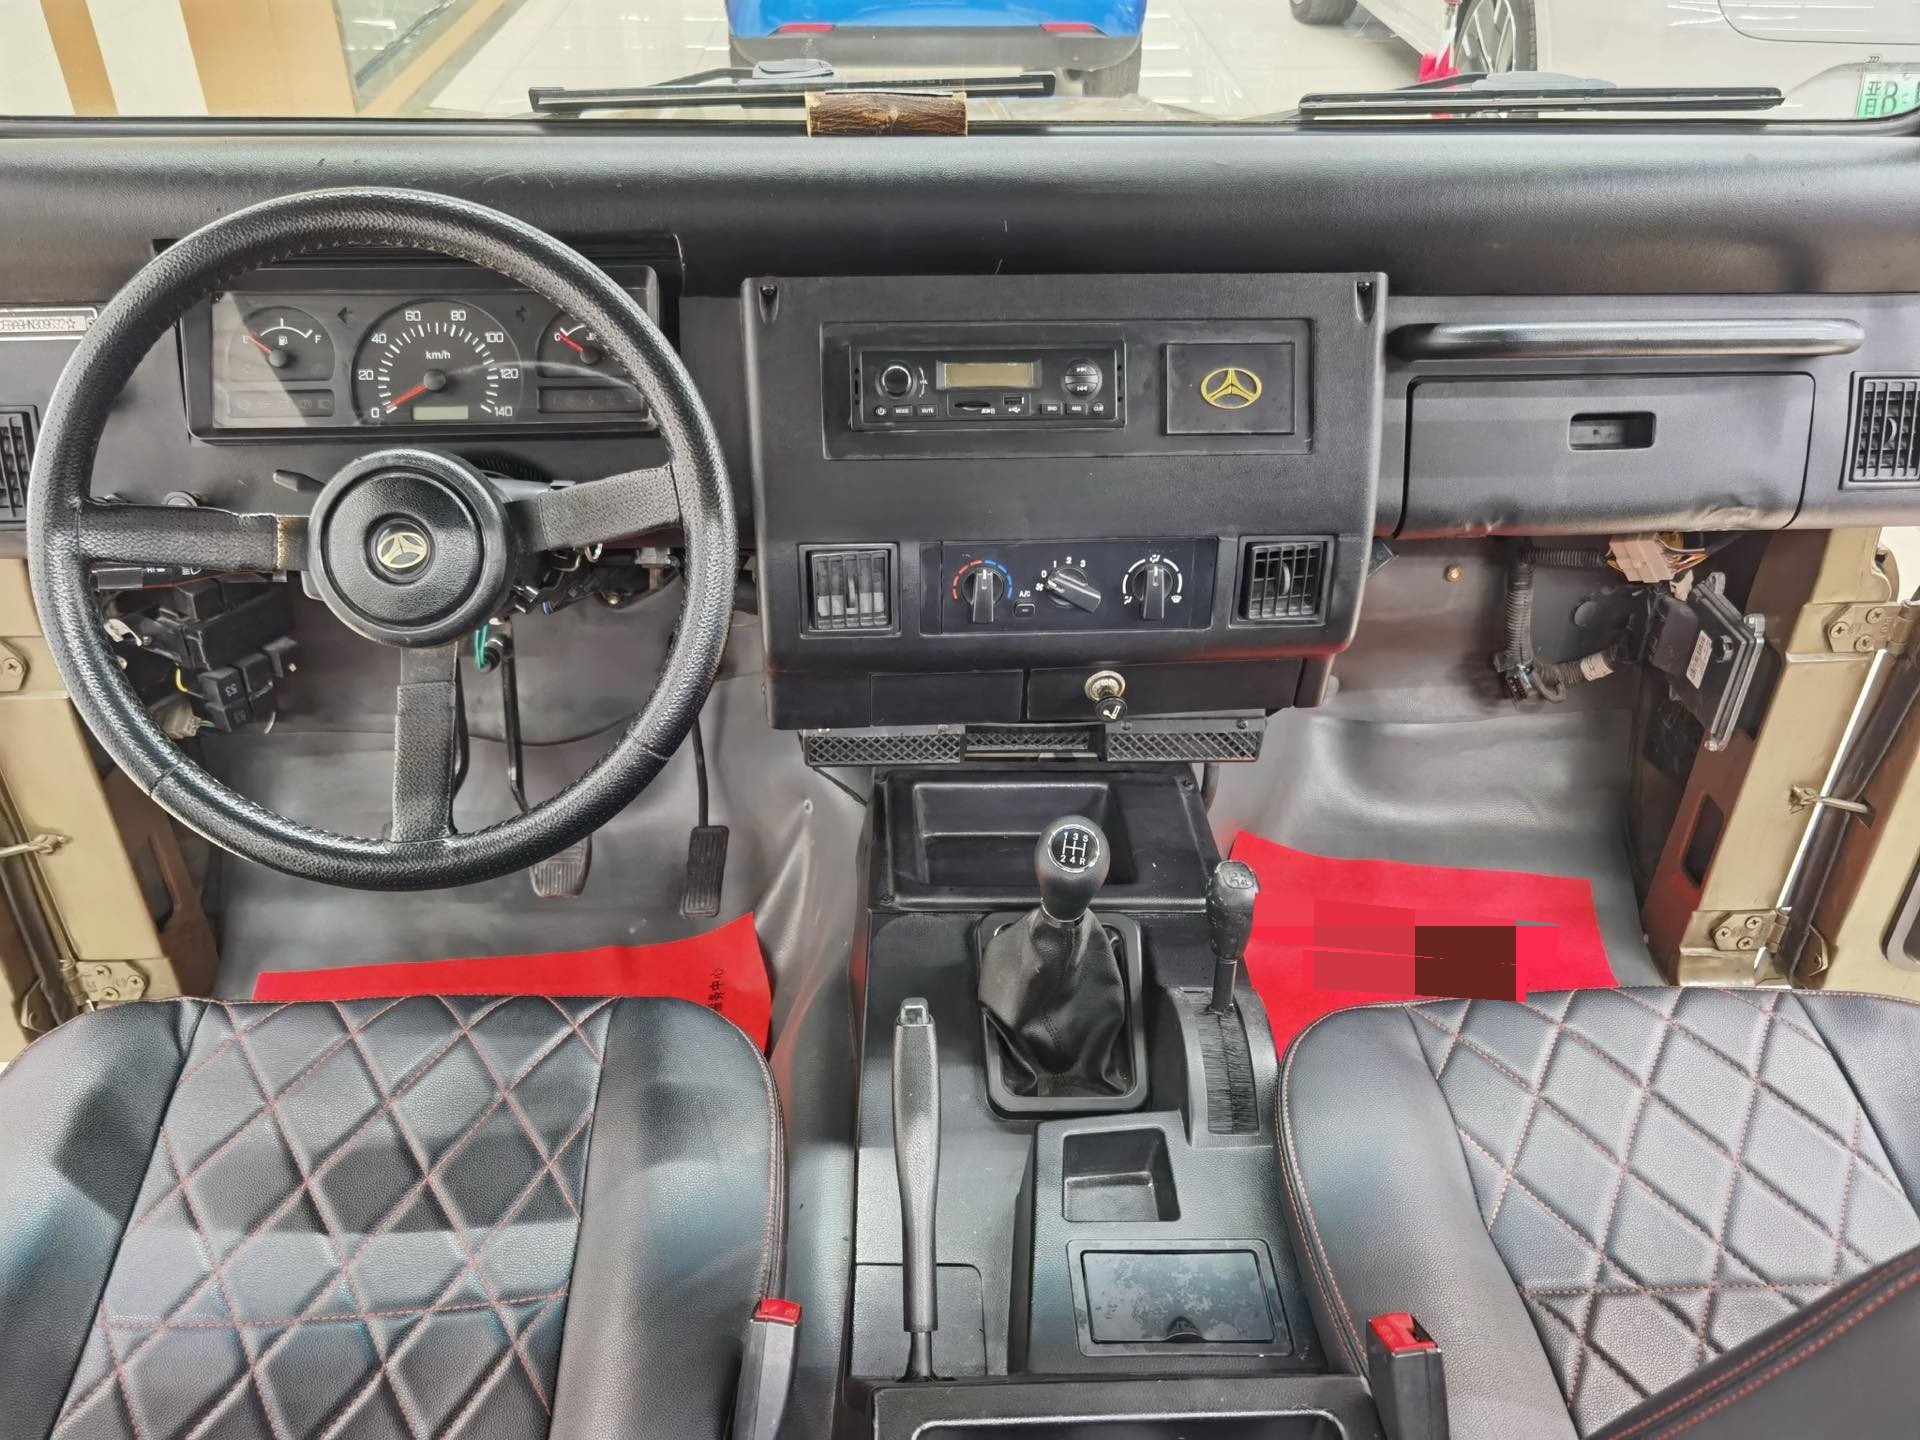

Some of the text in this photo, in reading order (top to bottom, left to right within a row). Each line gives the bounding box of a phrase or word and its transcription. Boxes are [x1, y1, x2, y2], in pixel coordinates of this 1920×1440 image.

[405, 310, 421, 322] 60
[451, 310, 466, 321] 80
[242, 335, 249, 344] E
[315, 335, 322, 344] F
[371, 333, 387, 344] 40
[484, 332, 504, 343] 100
[426, 350, 450, 360] km/h
[358, 369, 374, 381] 20
[500, 368, 519, 379] 120
[371, 407, 379, 418] 0
[494, 405, 513, 417] 140
[1053, 560, 1057, 568] 1
[1066, 556, 1072, 564] 2
[1080, 559, 1086, 568] 3
[1041, 569, 1047, 578] 0
[1019, 590, 1031, 598] A/C
[1064, 831, 1089, 843] 1 3 5
[1060, 854, 1086, 866] 2 4 R
